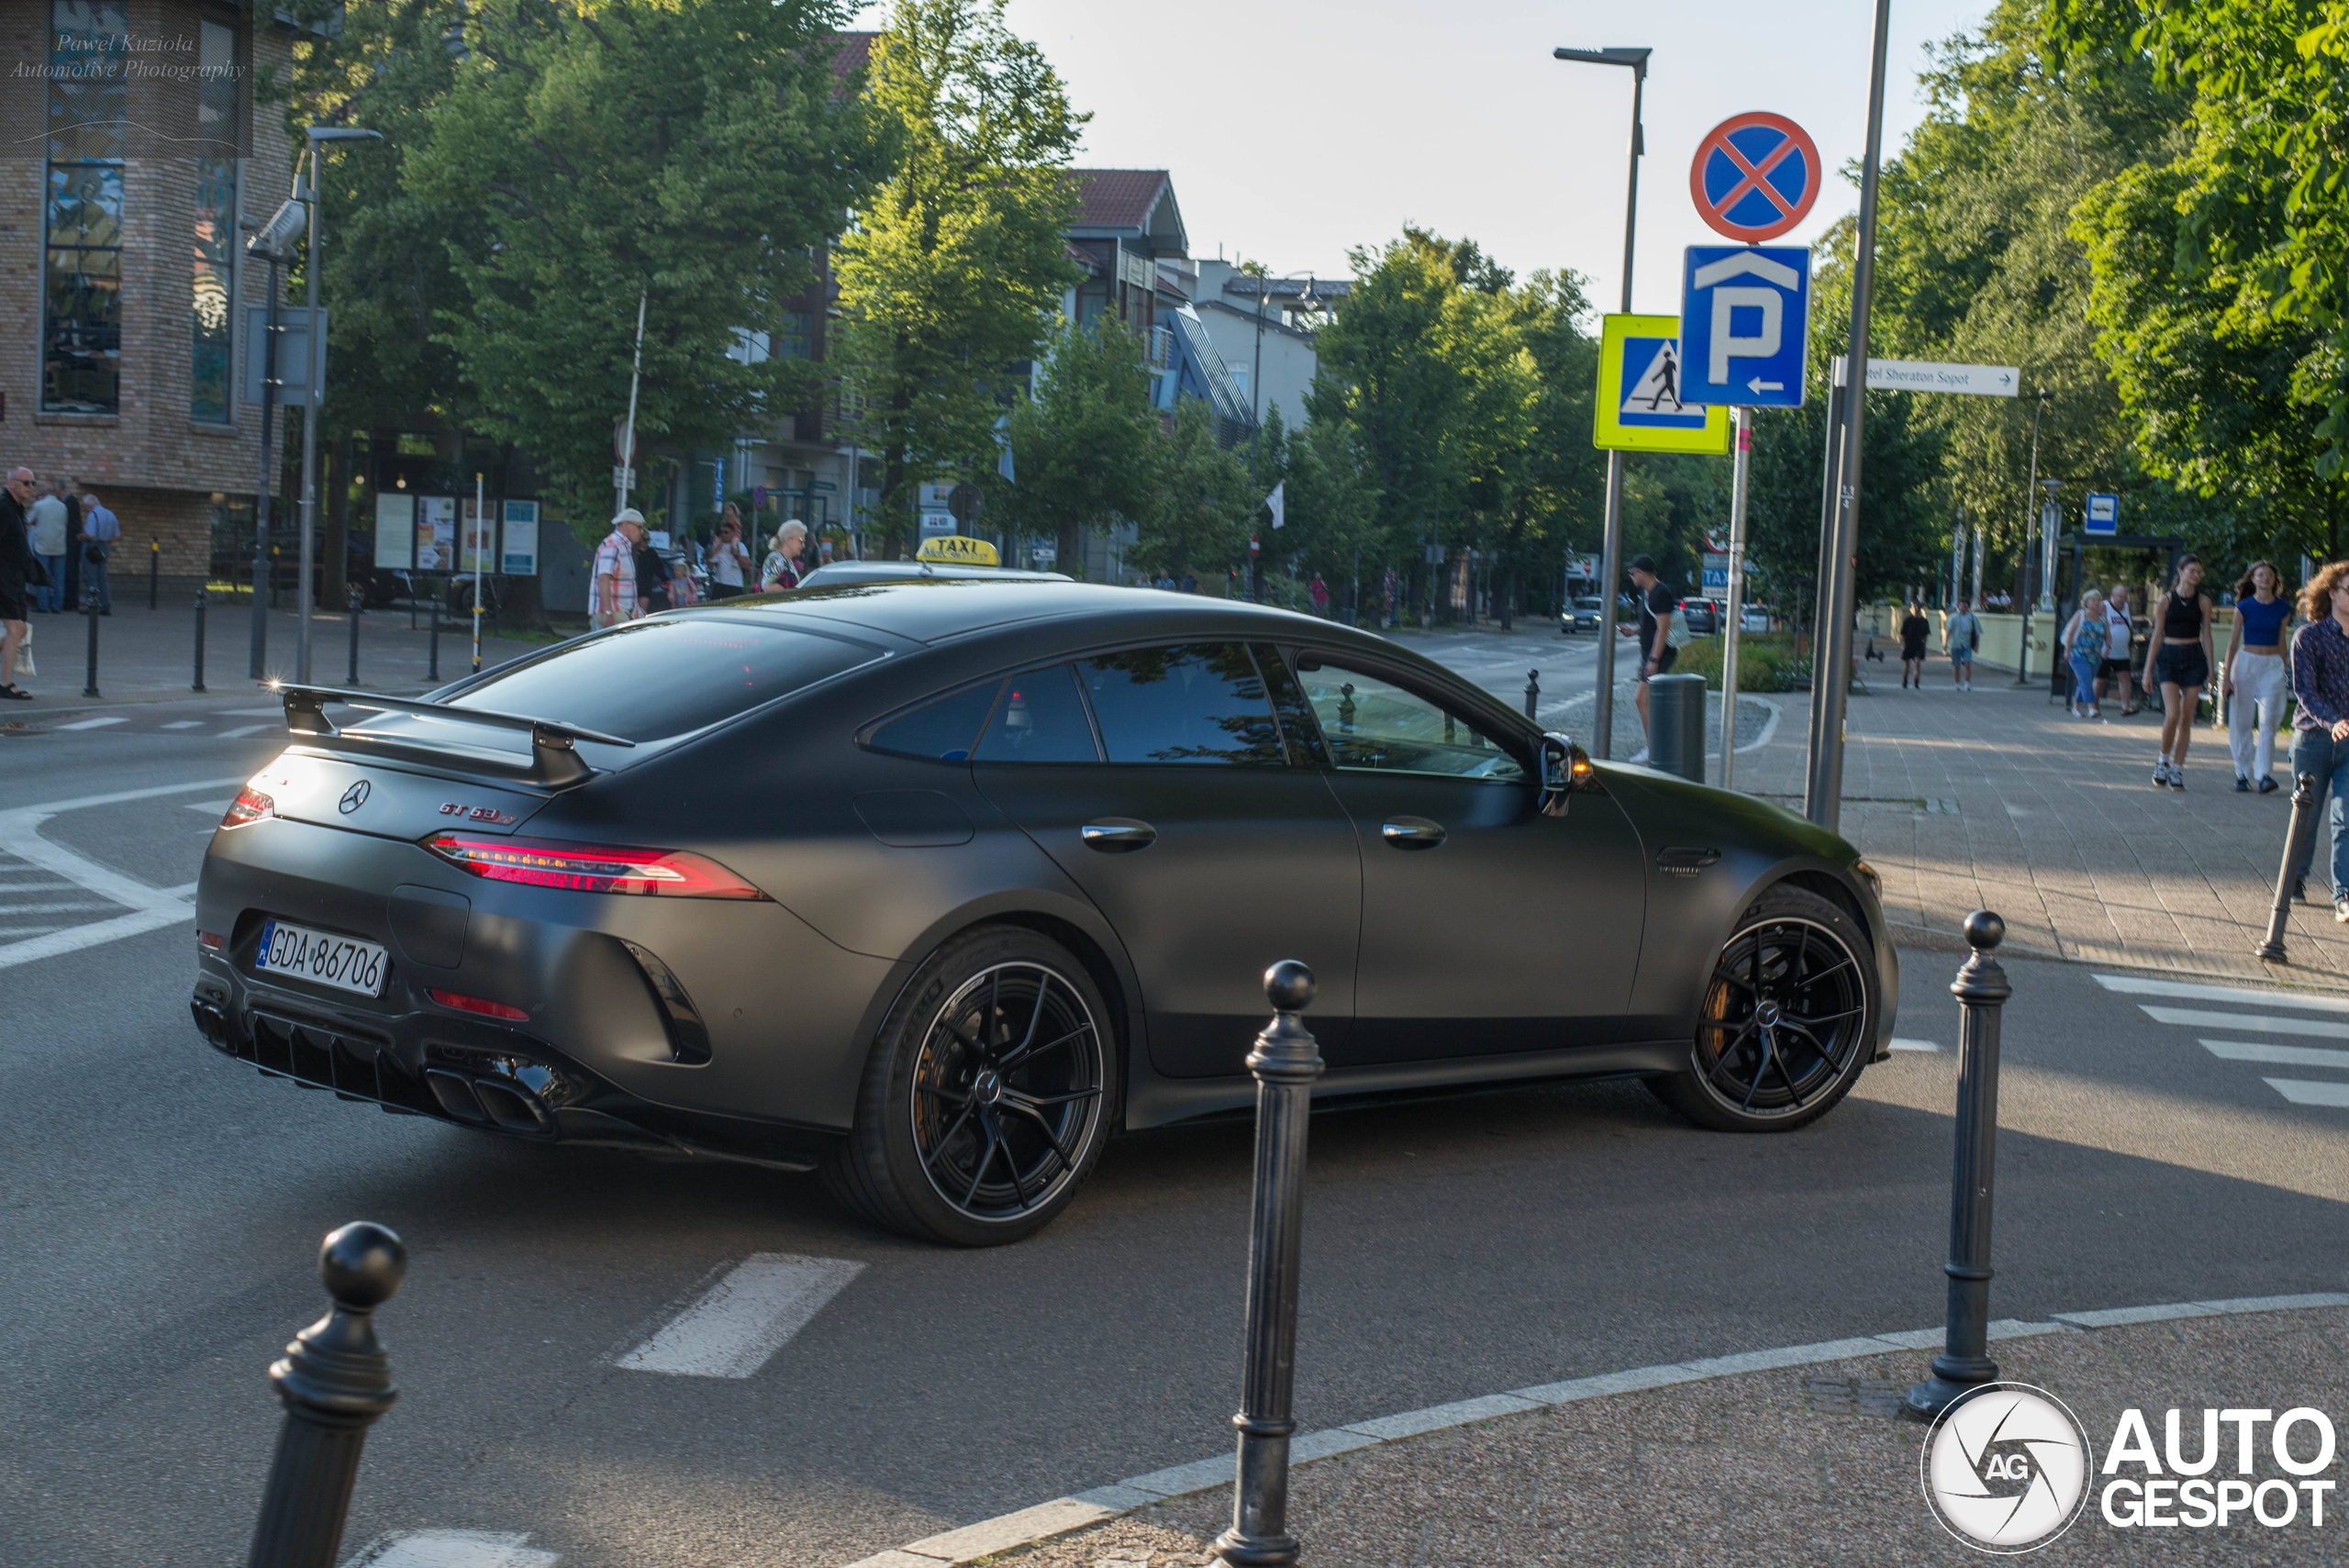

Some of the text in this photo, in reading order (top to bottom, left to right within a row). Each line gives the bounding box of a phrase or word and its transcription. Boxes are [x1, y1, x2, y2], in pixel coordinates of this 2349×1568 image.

[1708, 286, 1783, 384] P
[1886, 368, 1934, 382] Sheraton
[1937, 371, 1969, 387] Sopot
[937, 539, 977, 555] TAXI
[1704, 570, 1729, 584] TAX
[440, 803, 469, 817] GT
[469, 806, 500, 820] 63
[259, 948, 267, 961] PL
[269, 929, 383, 988] GDA 86706
